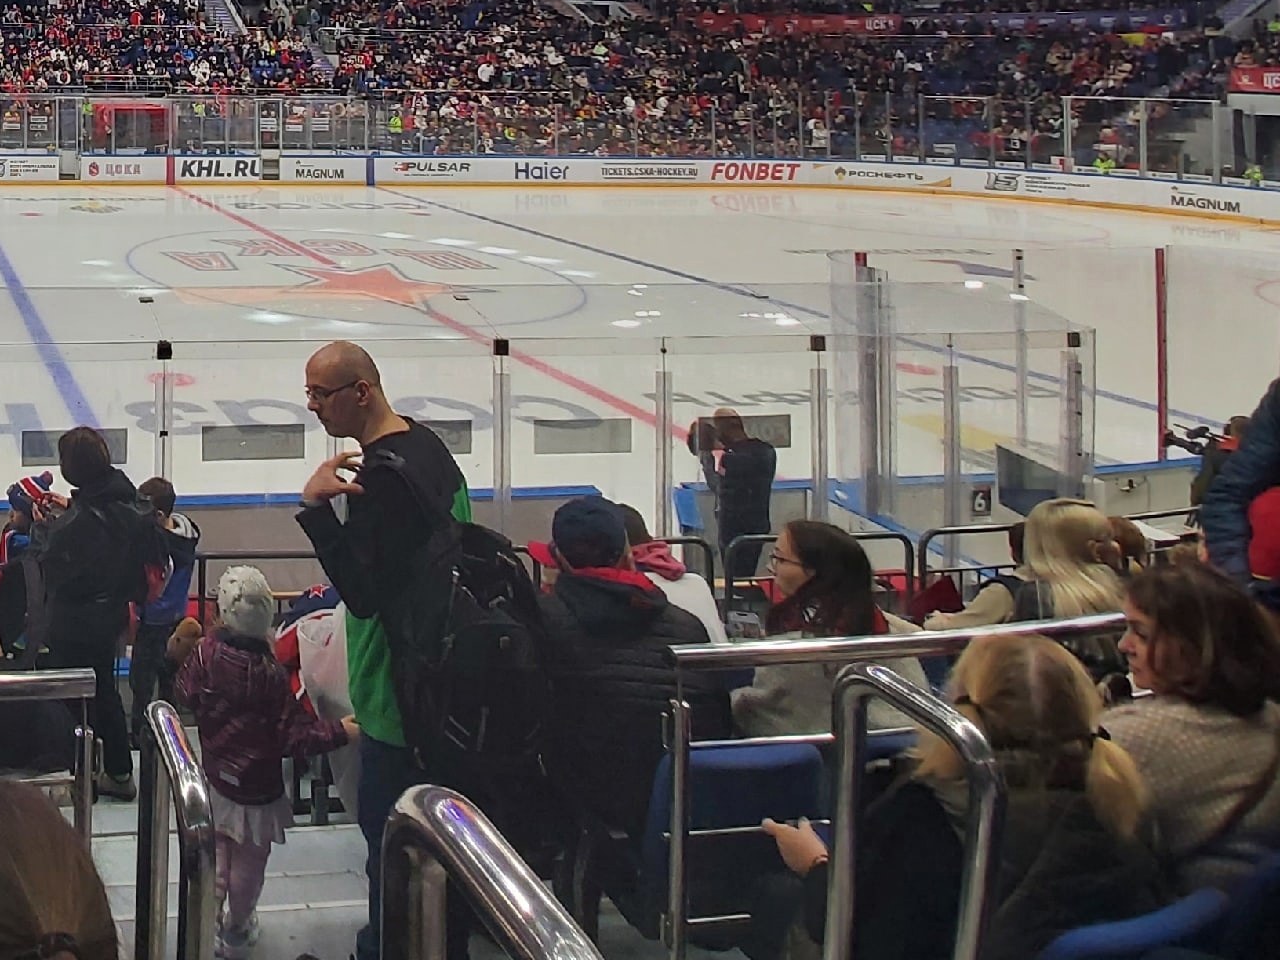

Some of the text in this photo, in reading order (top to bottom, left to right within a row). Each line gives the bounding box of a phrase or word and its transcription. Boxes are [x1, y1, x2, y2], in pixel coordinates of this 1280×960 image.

[181, 159, 260, 178] KHL.RU
[295, 169, 345, 179] MAGNUM
[406, 162, 471, 173] PULSAR
[514, 162, 570, 180] Haier
[601, 168, 699, 178] TICKETS.CSKA-HOCKEY.RU
[710, 162, 801, 181] FONBET
[848, 170, 925, 181] РОСНЕФТЬ
[1170, 194, 1241, 214] MAGNUM
[974, 491, 986, 511] 6
